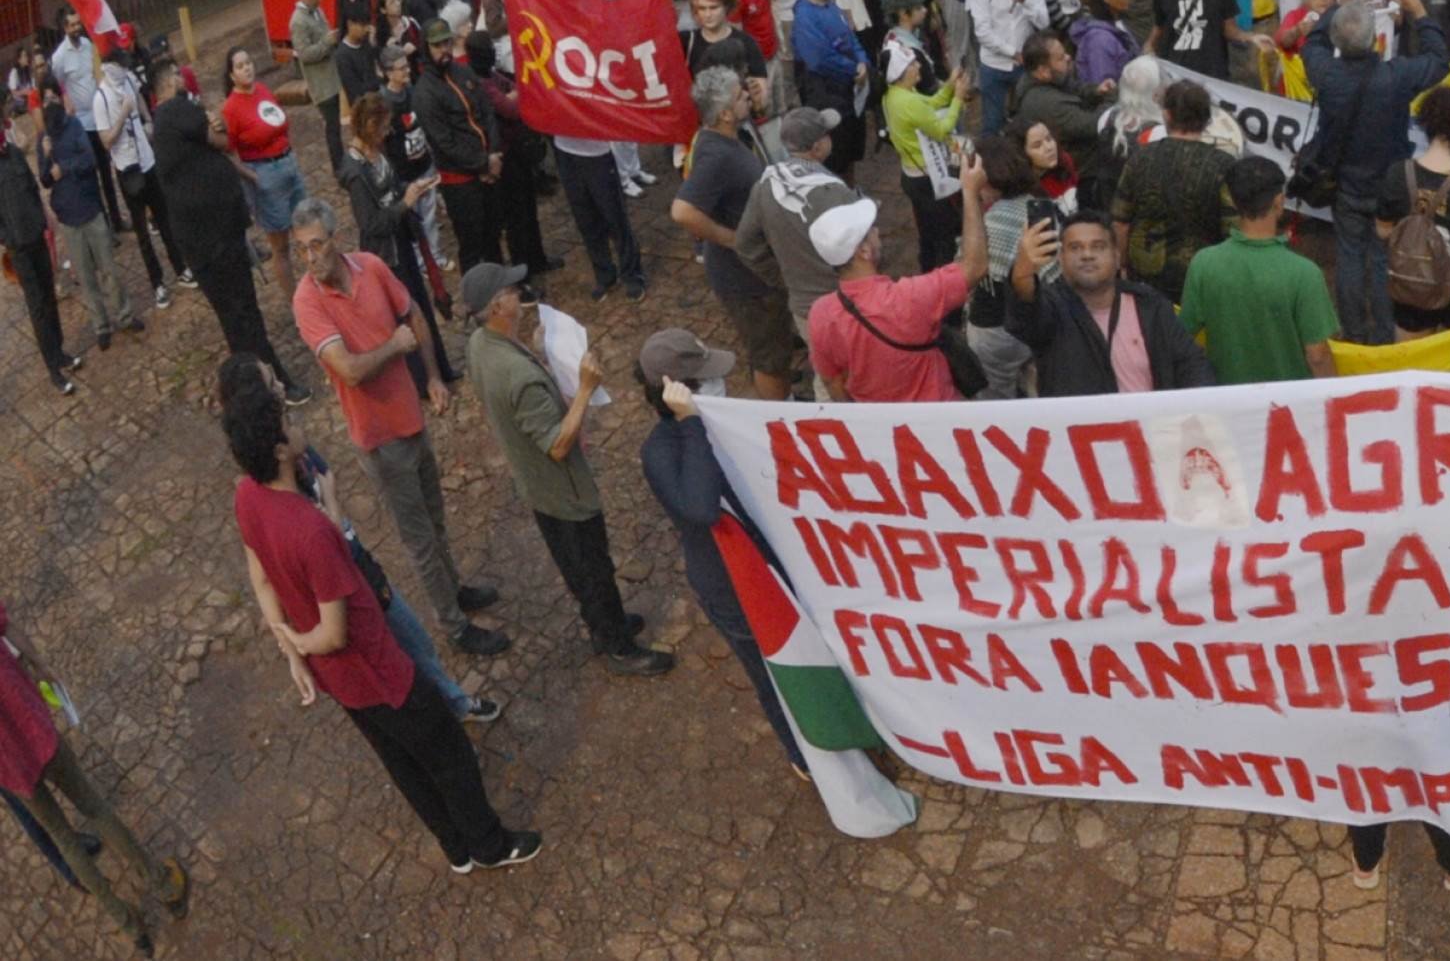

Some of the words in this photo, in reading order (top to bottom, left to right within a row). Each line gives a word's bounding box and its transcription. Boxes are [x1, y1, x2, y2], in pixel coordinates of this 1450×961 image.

[554, 36, 669, 101] OCI
[766, 418, 1168, 522] ABAIXO
[834, 608, 1044, 692] FORA
